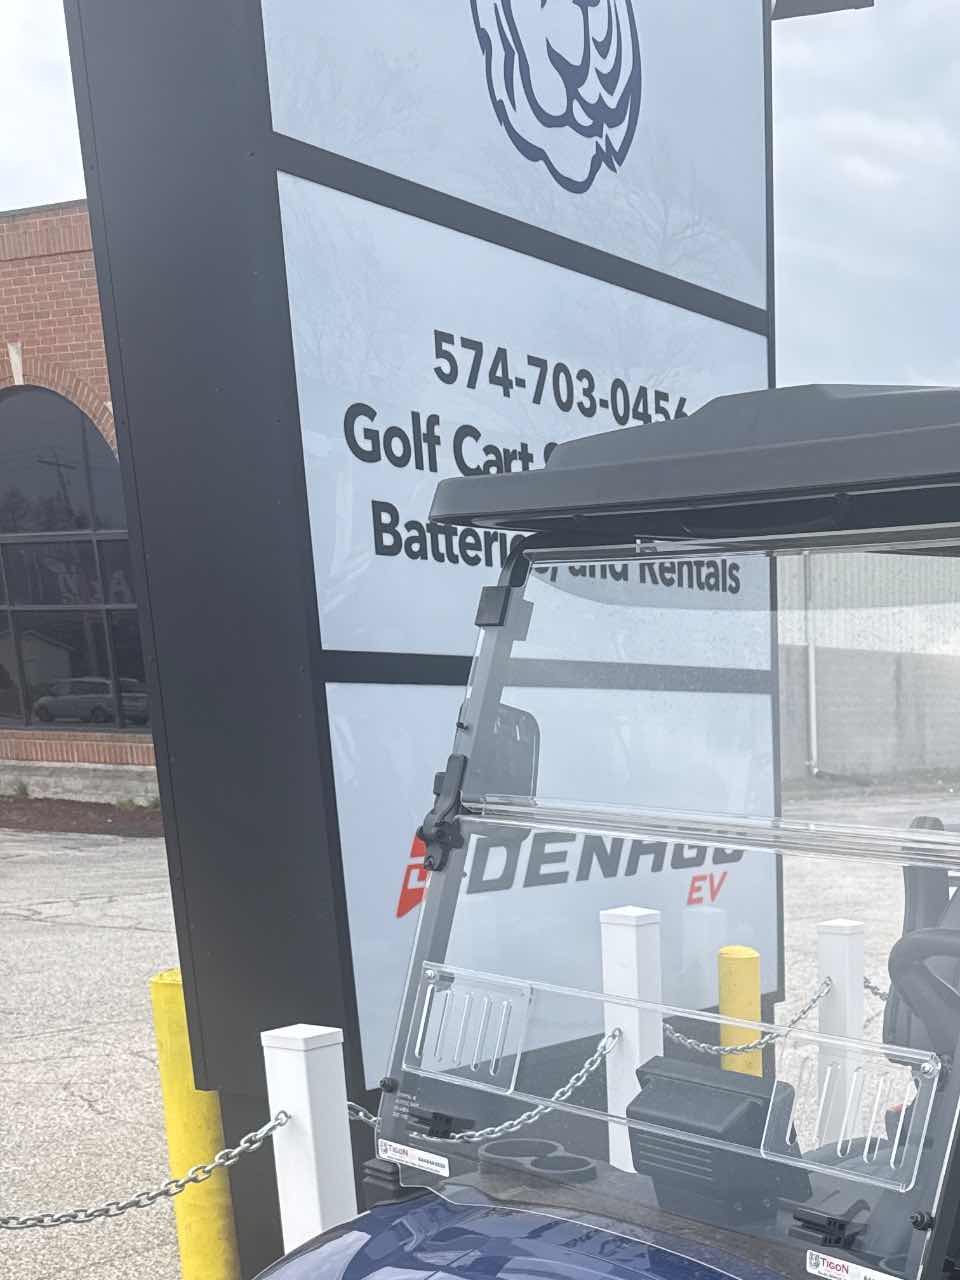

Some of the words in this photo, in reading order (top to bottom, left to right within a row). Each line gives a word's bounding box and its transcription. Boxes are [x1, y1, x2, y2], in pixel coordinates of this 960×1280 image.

[344, 403, 441, 473] Golf
[453, 424, 534, 477] Cart
[639, 558, 741, 595] Rentals
[687, 871, 728, 906] EV
